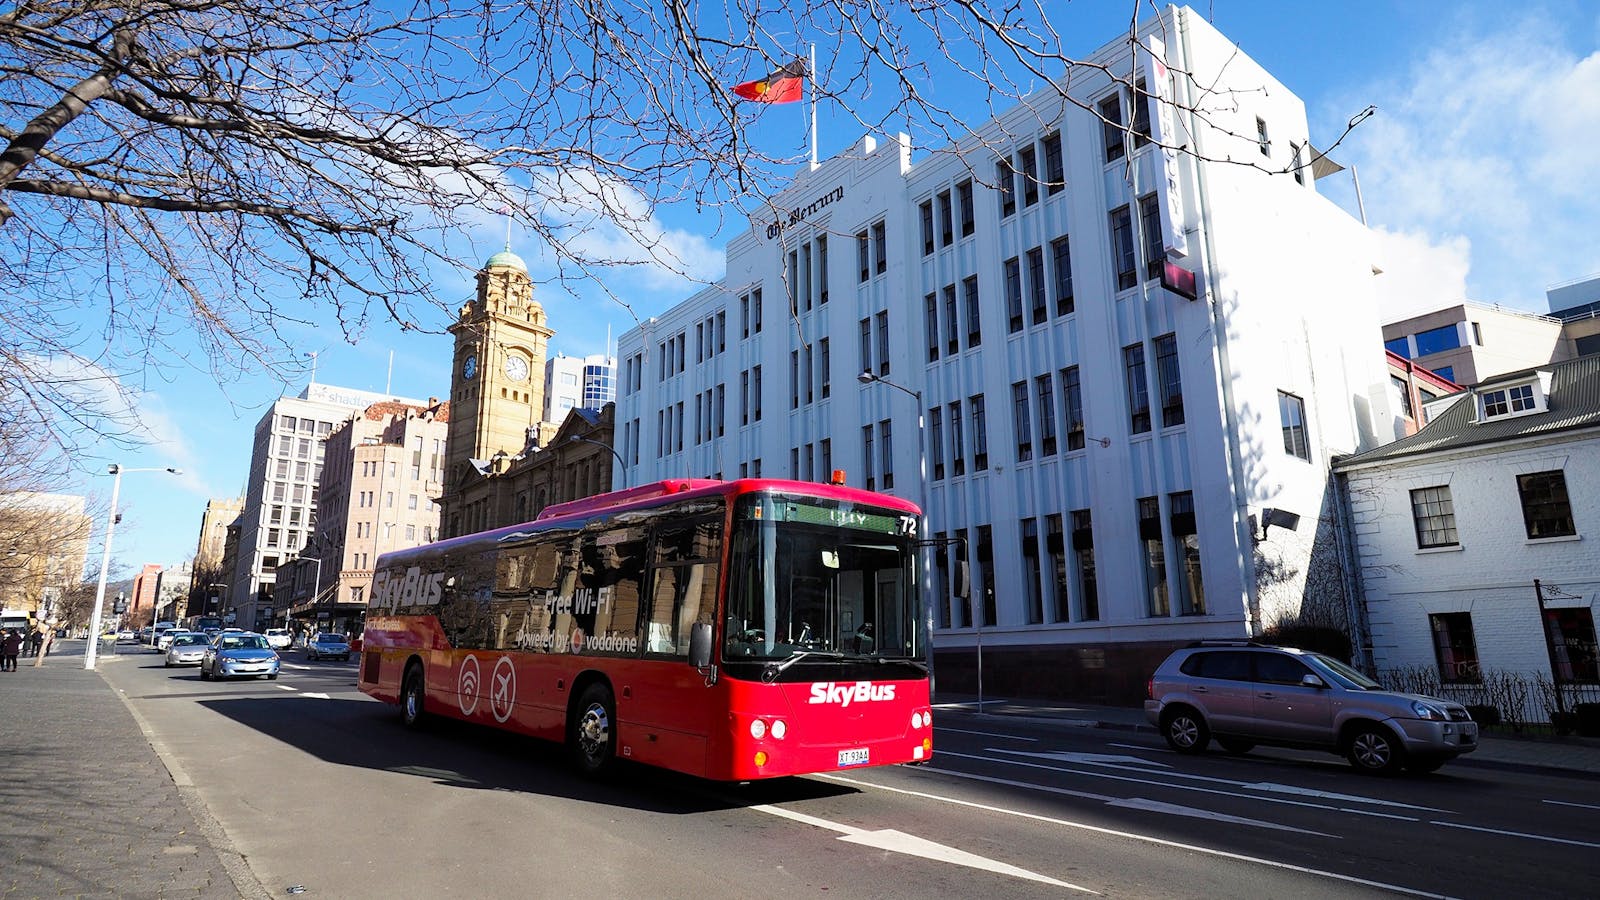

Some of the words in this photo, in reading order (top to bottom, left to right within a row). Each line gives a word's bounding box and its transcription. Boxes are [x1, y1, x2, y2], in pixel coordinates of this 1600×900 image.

[787, 185, 844, 229] Mercury
[900, 515, 917, 535] 72
[369, 566, 445, 616] SkyBus
[545, 589, 572, 614] Free
[575, 587, 611, 615] Wi-Fi
[586, 631, 637, 653] vodafone
[808, 681, 896, 708] SkyBus
